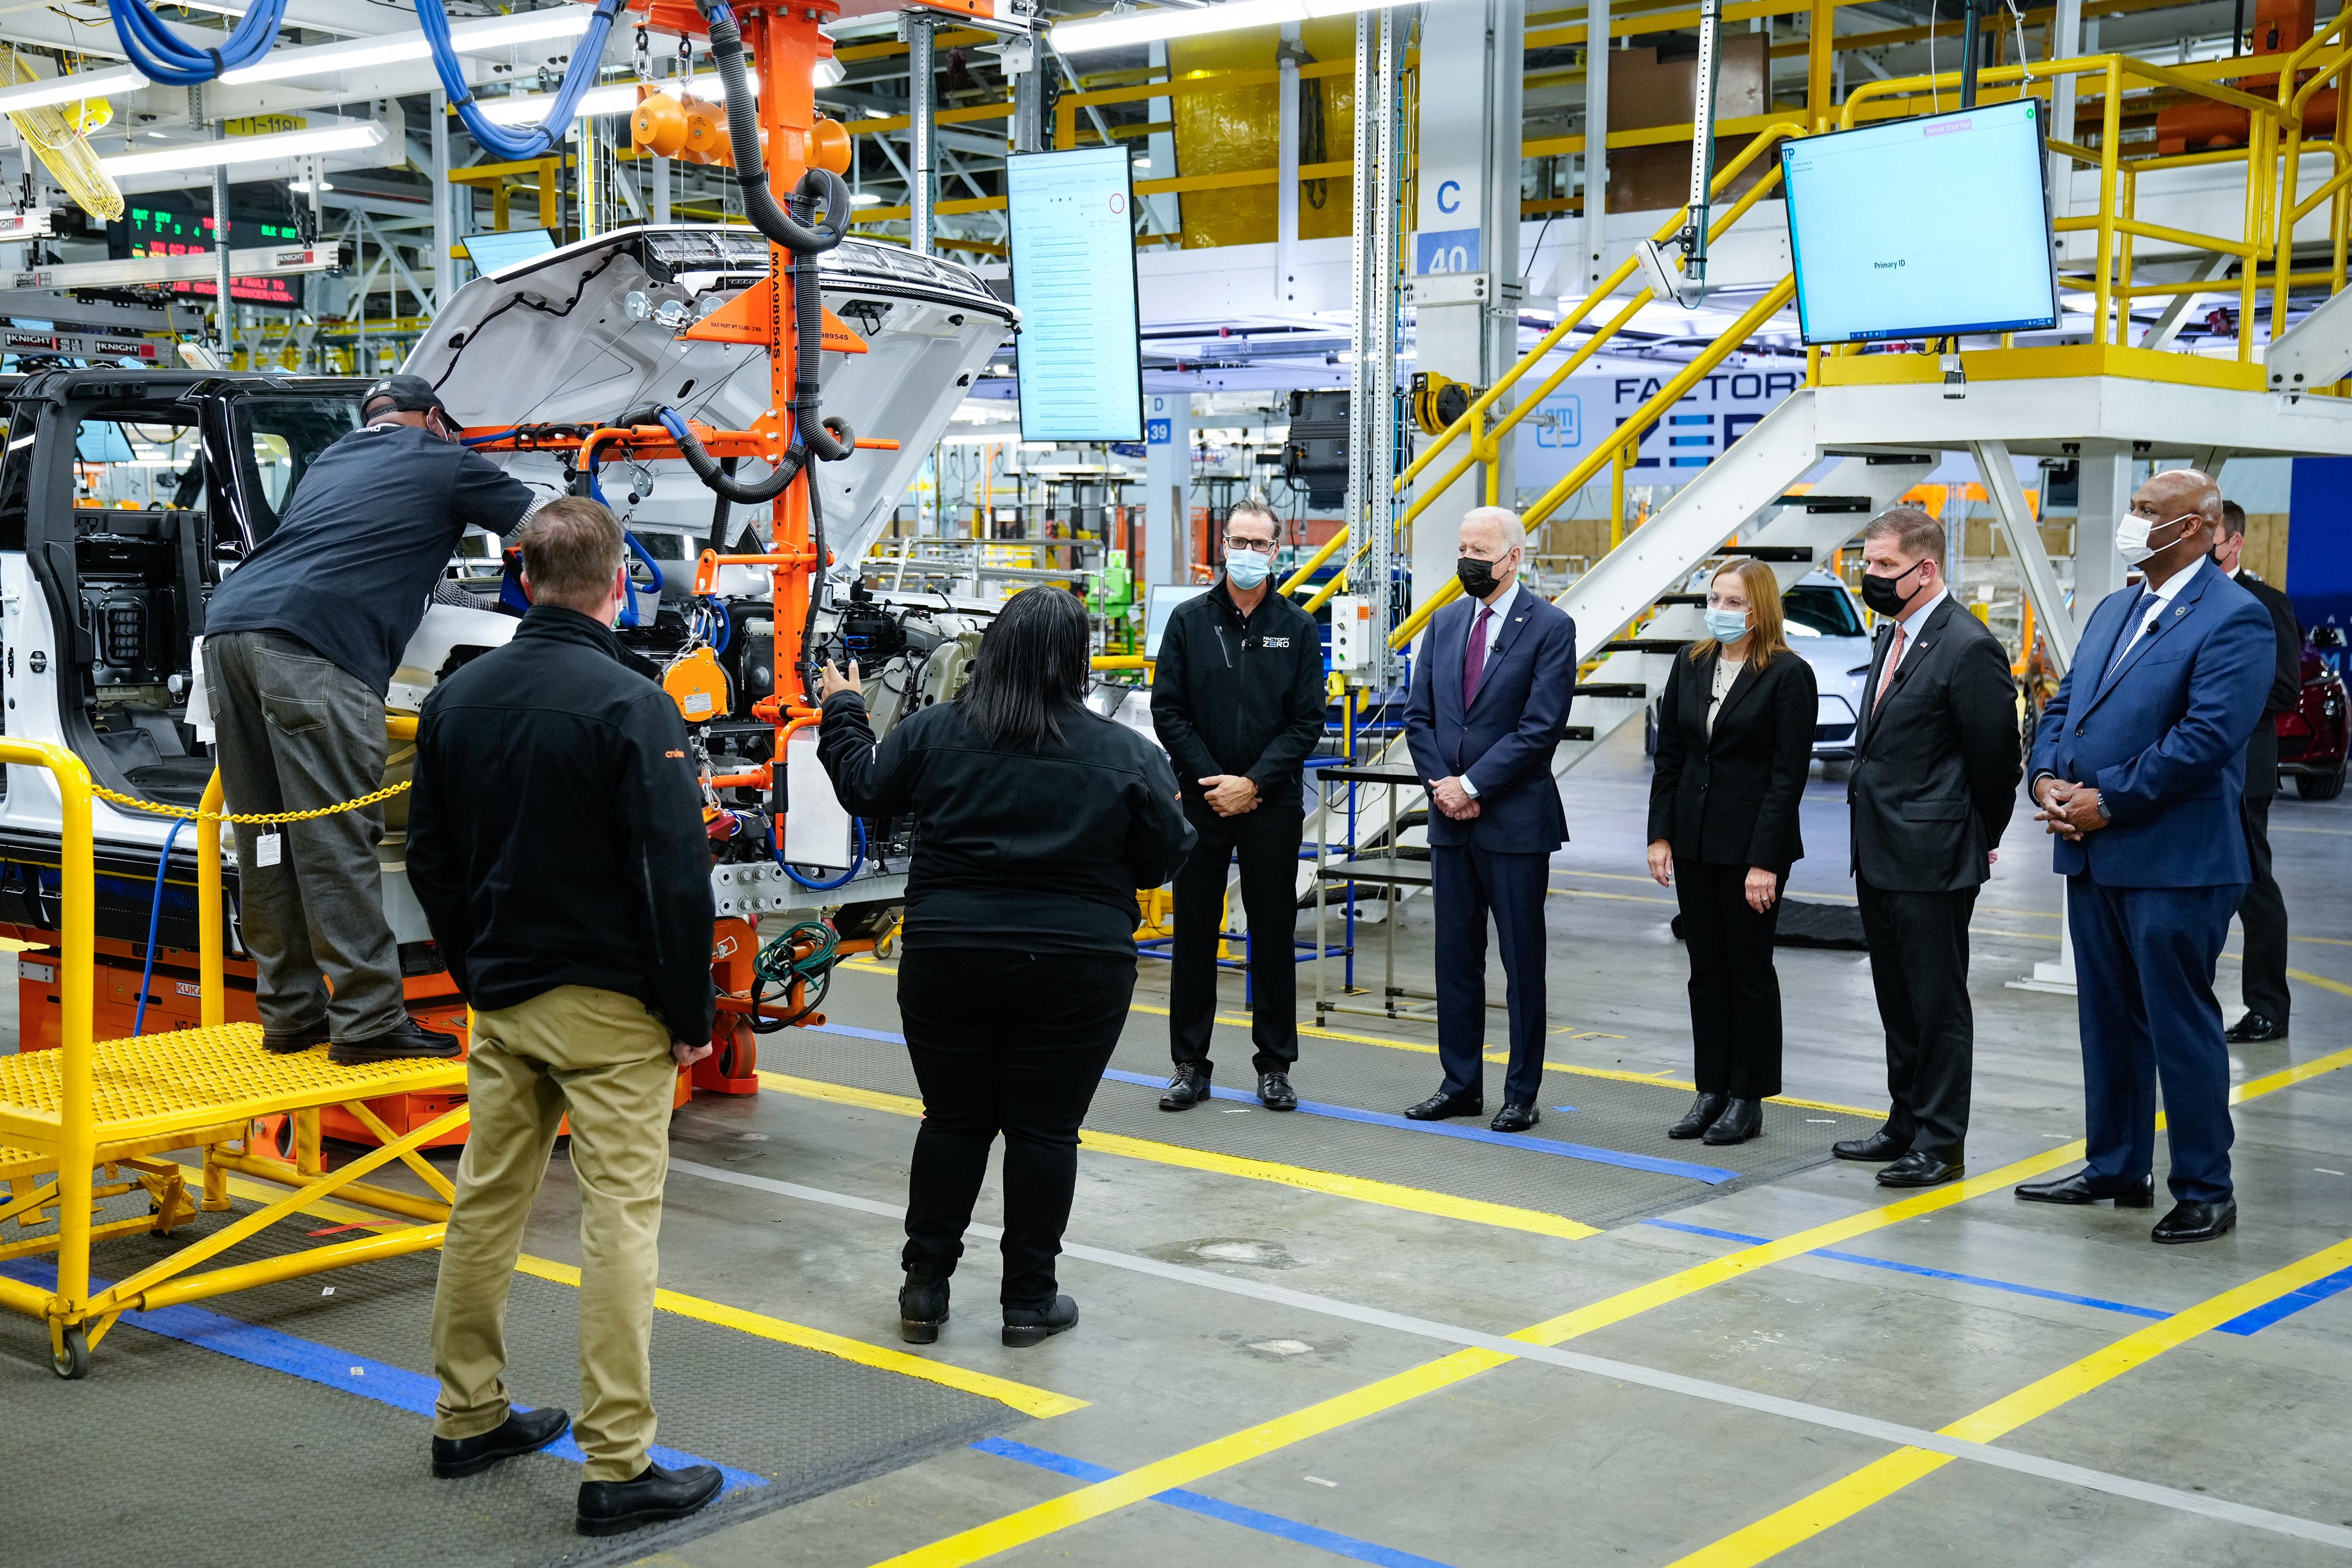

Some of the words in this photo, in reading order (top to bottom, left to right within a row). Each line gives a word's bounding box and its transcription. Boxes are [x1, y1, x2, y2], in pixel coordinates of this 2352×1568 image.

[1927, 126, 1945, 134] Manual
[1437, 180, 1460, 214] C
[155, 222, 162, 233] 2
[193, 226, 200, 237] 4
[1429, 246, 1467, 274] 40
[1874, 261, 1897, 269] Primary
[272, 279, 285, 291] TO
[772, 252, 780, 359] MAA98954S
[11, 334, 52, 344] KNIGHT
[101, 342, 139, 353] KNIGHT
[1615, 372, 1807, 404] FATOR
[1155, 398, 1163, 411] D
[1151, 424, 1168, 440] 39
